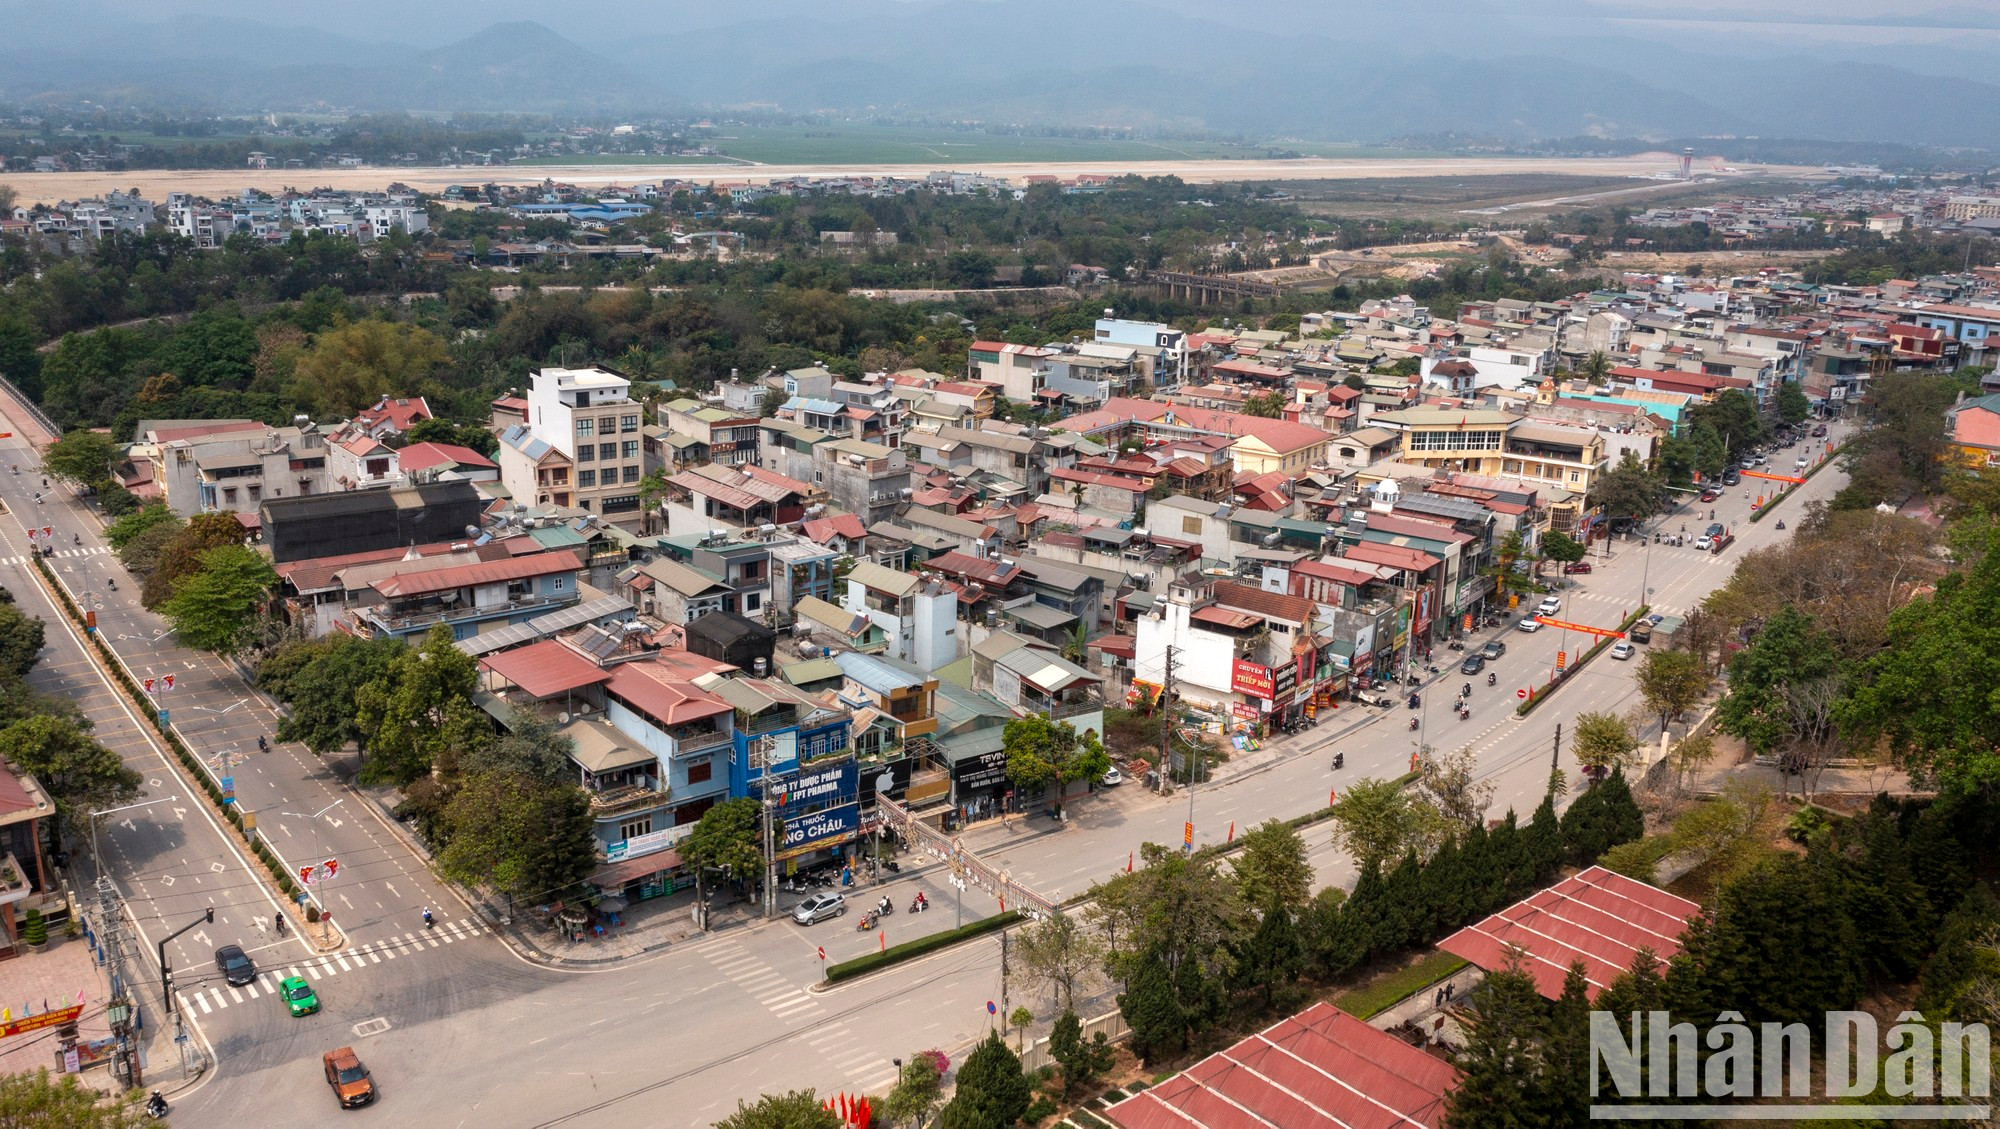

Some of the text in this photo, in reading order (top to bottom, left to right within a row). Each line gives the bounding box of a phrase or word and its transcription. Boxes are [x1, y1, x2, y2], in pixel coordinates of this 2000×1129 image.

[1238, 664, 1263, 675] CHUYÊN
[1236, 673, 1257, 686] THIẾP
[1257, 679, 1271, 689] MỜI
[789, 780, 798, 791] TY
[800, 775, 820, 788] DƯỢC
[821, 768, 842, 782] PHẨM
[793, 781, 838, 801] FPT PHARMA
[802, 814, 826, 827] THUỐC
[807, 818, 843, 837] CHÂU
